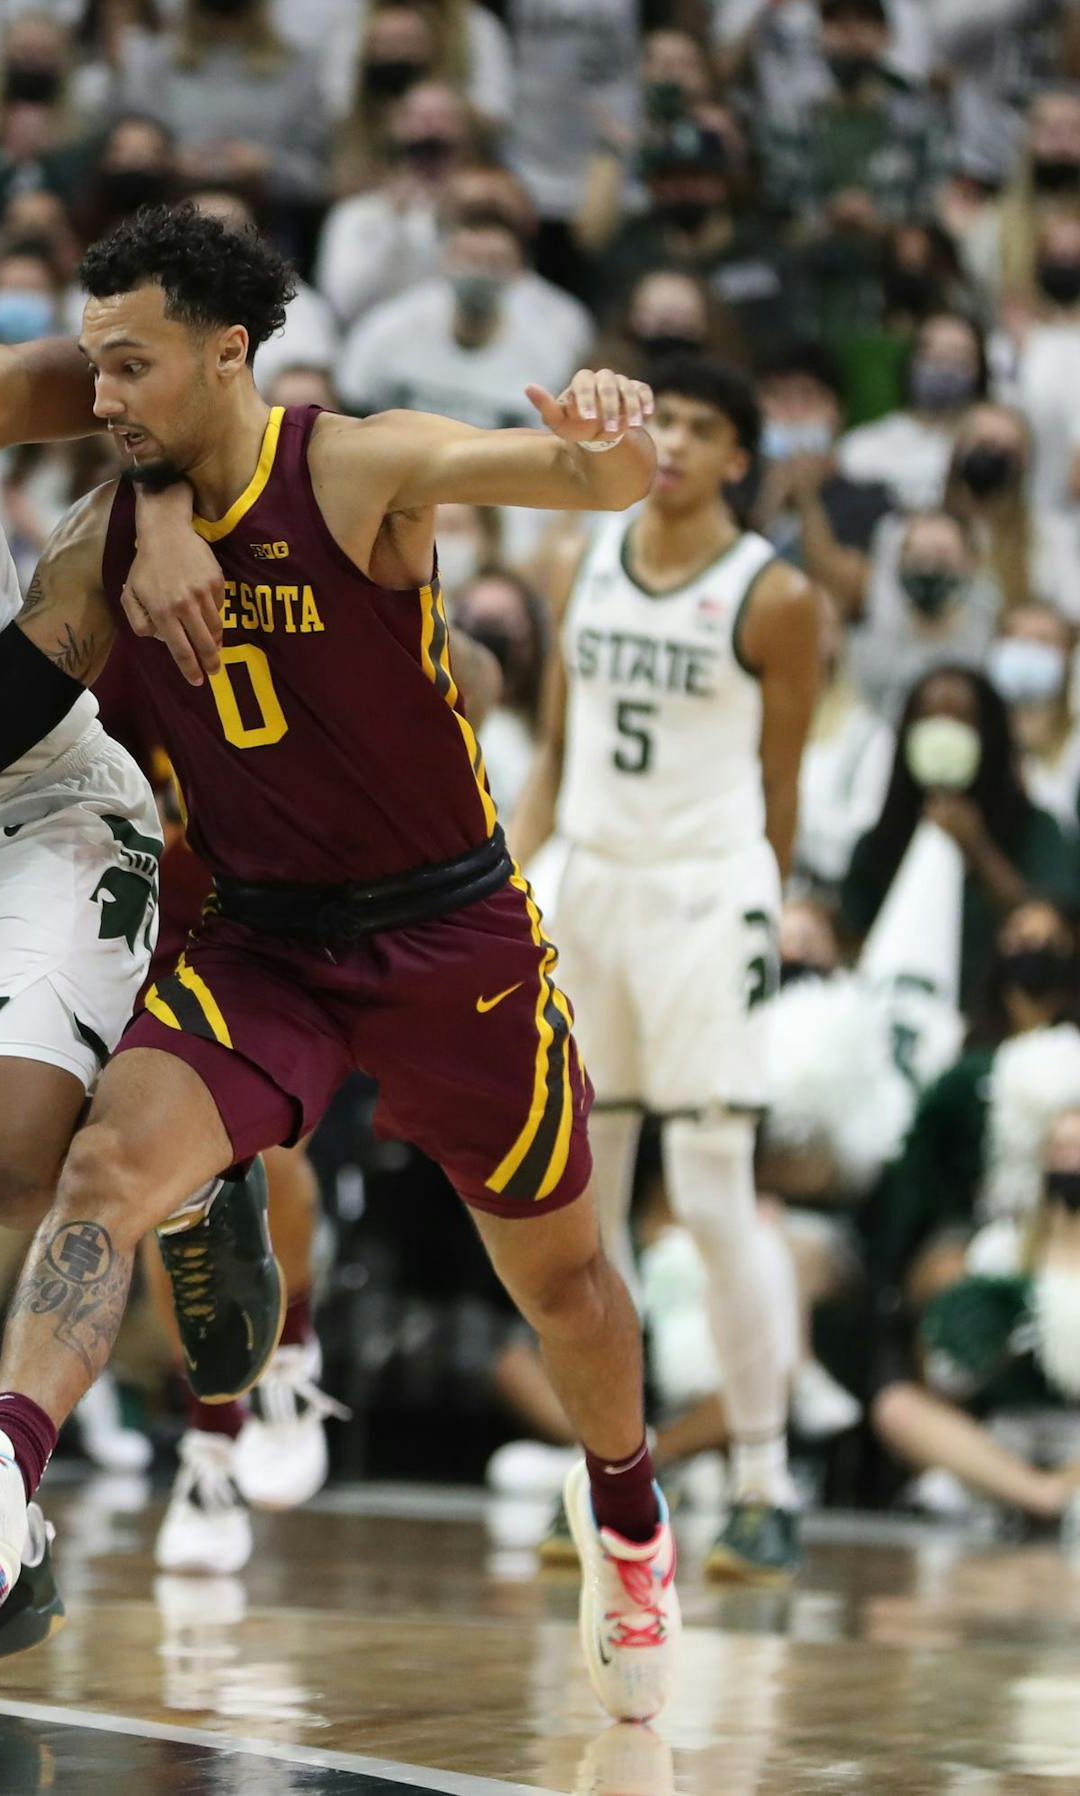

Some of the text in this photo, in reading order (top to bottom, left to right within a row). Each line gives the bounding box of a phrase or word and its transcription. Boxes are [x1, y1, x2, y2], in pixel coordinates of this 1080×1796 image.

[219, 581, 325, 633] ESOTA
[207, 643, 289, 749] 0
[577, 629, 719, 697] STATE
[614, 701, 657, 775] 5
